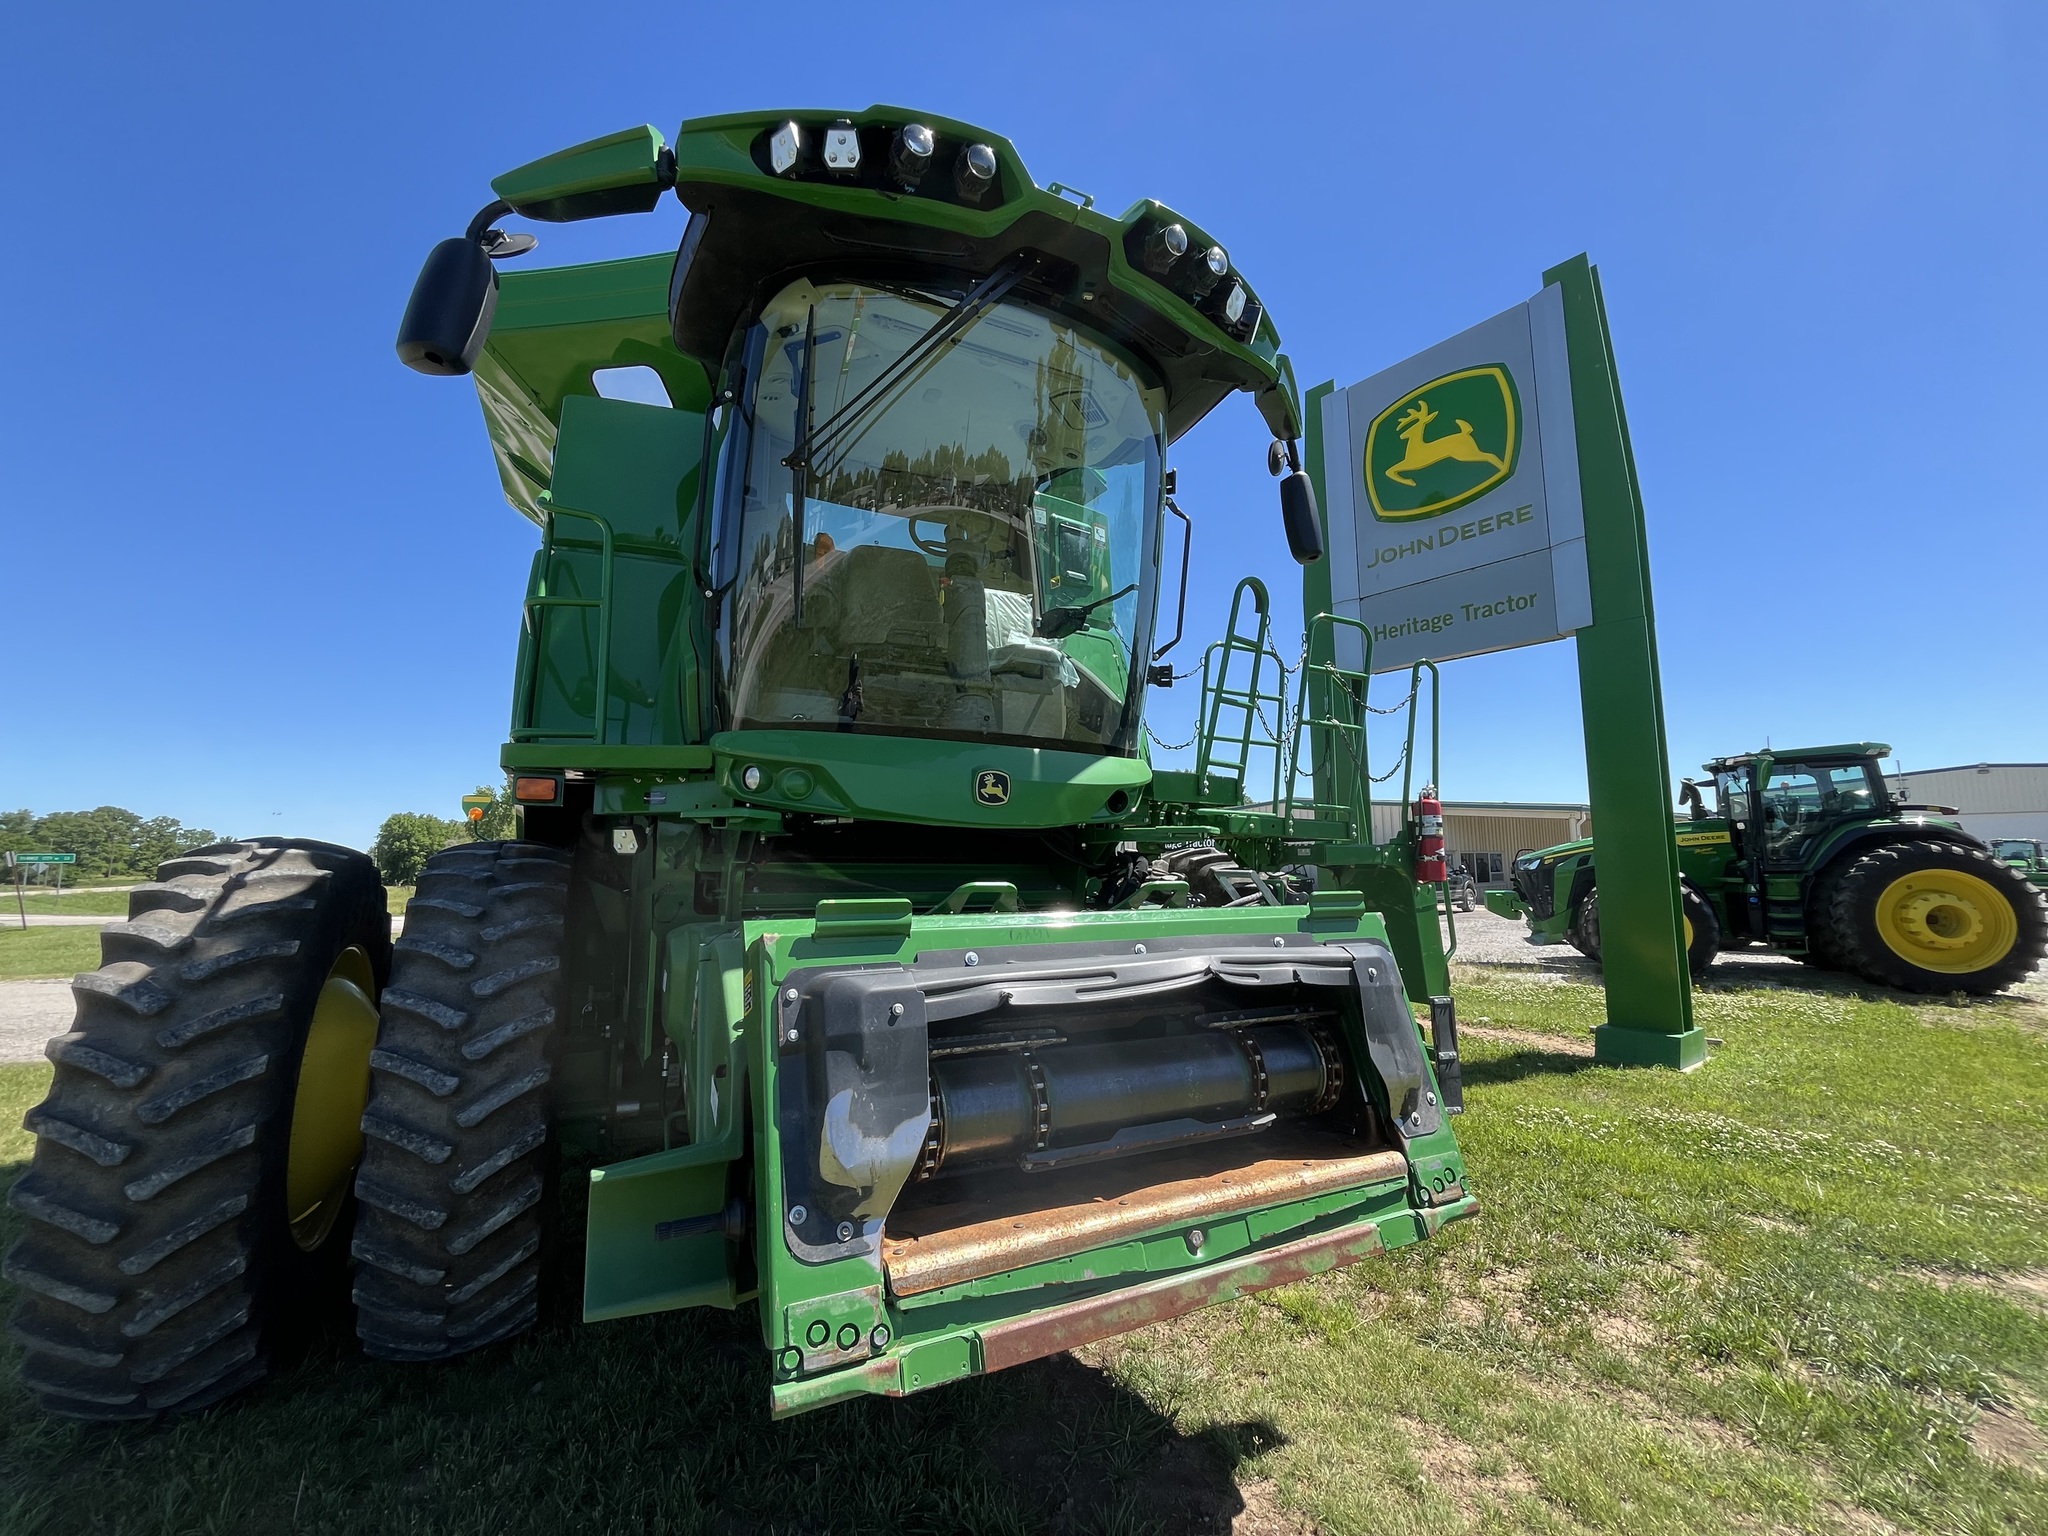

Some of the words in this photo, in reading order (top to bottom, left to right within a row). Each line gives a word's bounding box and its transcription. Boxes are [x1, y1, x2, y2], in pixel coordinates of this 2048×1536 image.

[1367, 535, 1434, 569] JOHN
[1438, 504, 1534, 547] DEERE
[1373, 612, 1454, 642] Heritage
[1460, 592, 1538, 622] Tractor
